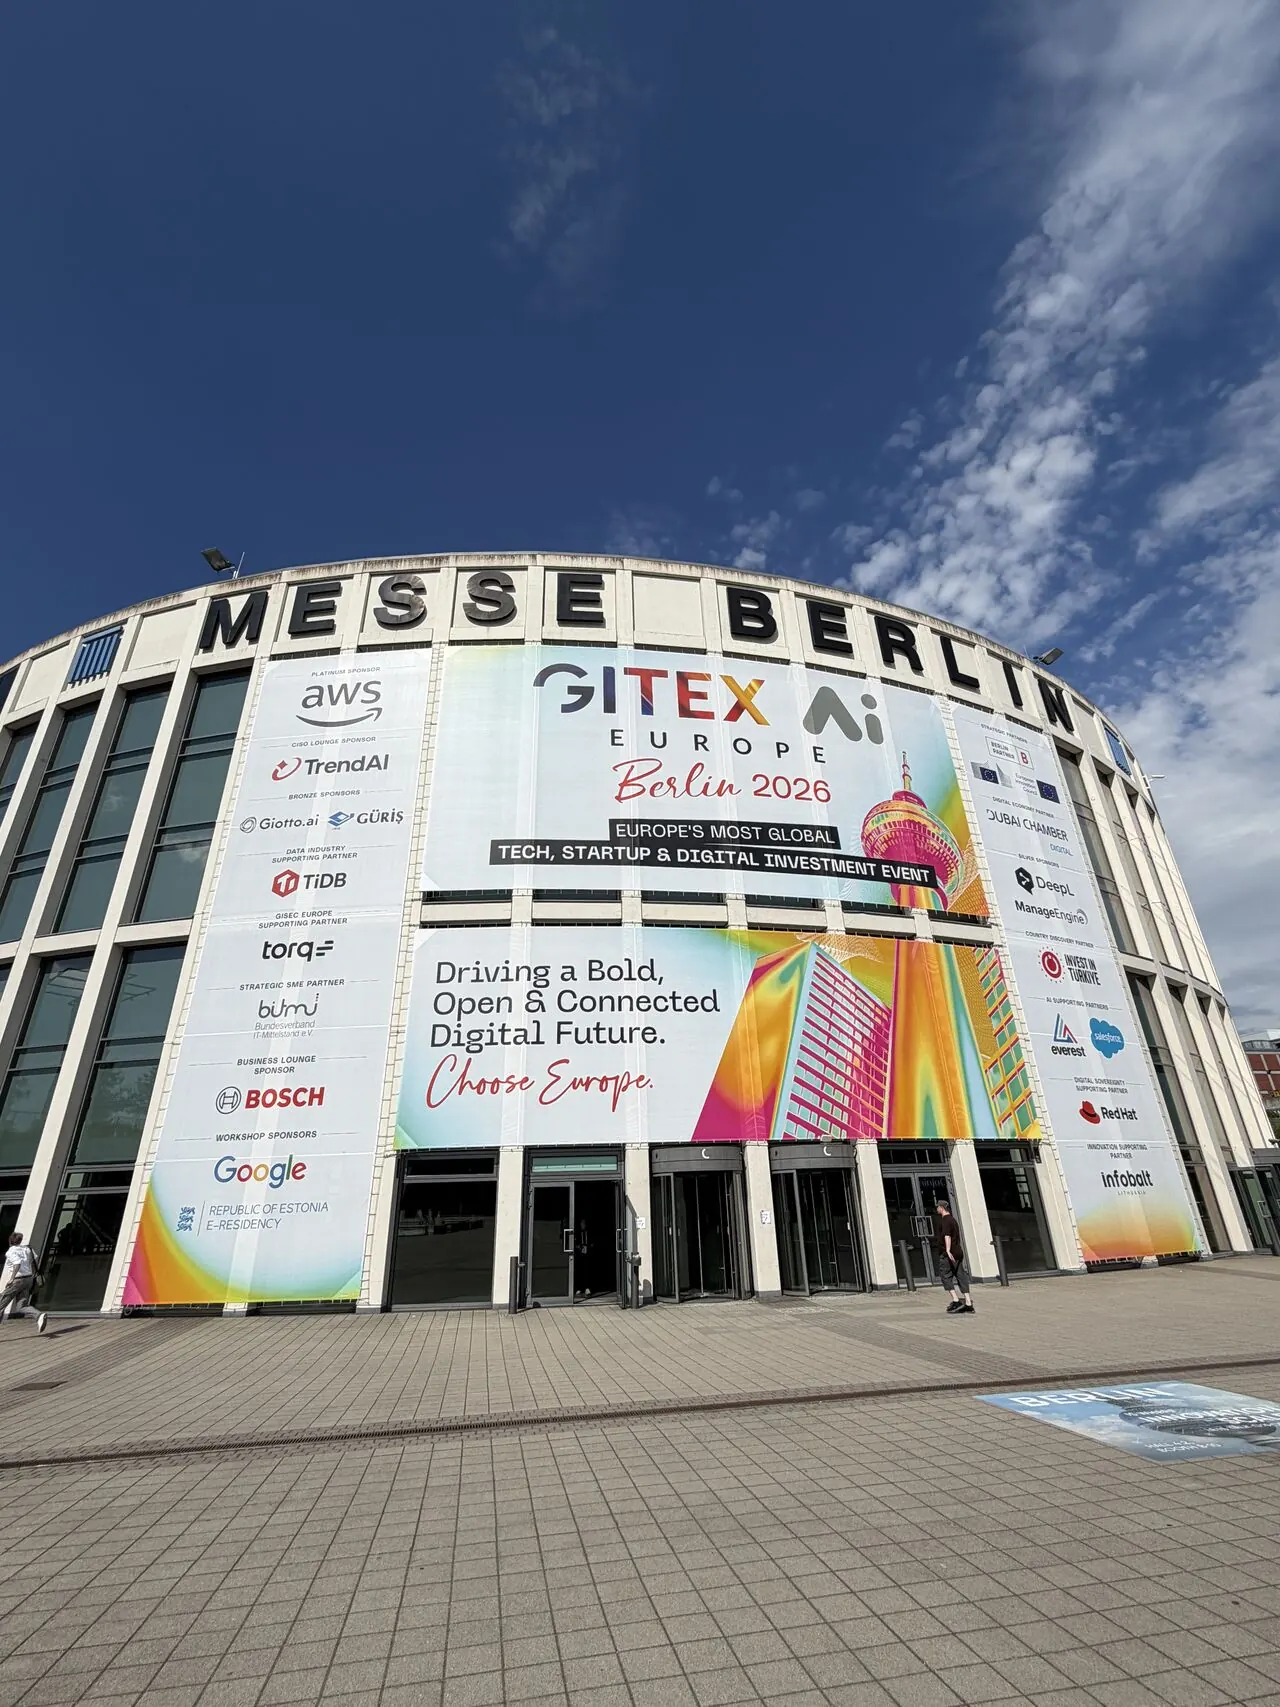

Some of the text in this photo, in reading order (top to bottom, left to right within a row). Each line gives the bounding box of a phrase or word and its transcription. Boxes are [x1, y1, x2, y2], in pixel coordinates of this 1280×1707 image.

[199, 571, 1074, 733] MESSE BERLIN
[312, 668, 346, 677] PLATINUM
[302, 680, 382, 708] aws
[533, 663, 770, 726] GITEX
[310, 738, 339, 746] LOUNGE
[610, 729, 826, 764] EUROPE
[991, 742, 1008, 751] BERLIN
[992, 748, 1014, 758] PARTNER
[1020, 752, 1028, 764] B
[305, 754, 389, 776] TrendAI
[612, 758, 832, 804] Berlin 2026
[320, 790, 360, 798] SPONSORS
[992, 796, 1011, 806] DIGITAL
[259, 814, 320, 830] Giotto.ai
[356, 808, 404, 824] GÜRİŞ
[616, 822, 835, 844] EUROPE'S MOST GLOBAL
[986, 808, 1068, 842] DUBAI CHAMBER
[272, 852, 358, 864] SUPPORTING PARTNER
[1050, 844, 1074, 856] DIGITAL
[498, 845, 930, 882] TECH, STARTUP & DIGITAL INVESTMENT EVENT
[303, 872, 347, 890] TiDB
[1036, 876, 1074, 896] DeepL
[276, 910, 332, 920] GISEC EUROPE
[1014, 900, 1086, 924] ManageEngine
[258, 918, 348, 929] SUPPORTING PARTNER
[262, 940, 314, 962] torq
[1064, 954, 1096, 971] INVEST IN
[436, 958, 664, 988] Driving a Bold,
[240, 982, 284, 991] STRATEGIC
[306, 979, 344, 987] PARTNER
[433, 988, 720, 1021] Open & Connected
[1052, 998, 1084, 1006] SUPPORTING
[254, 1020, 316, 1030] Bundesverband
[430, 1020, 665, 1054] Digital Future.
[1094, 1032, 1122, 1043] salesforce
[1052, 1046, 1086, 1056] everest
[236, 1056, 316, 1066] BUSINESS LOUNGE
[254, 1066, 295, 1075] SPONSOR
[426, 1054, 654, 1112] Choose Europe.
[245, 1086, 325, 1109] BOSCH
[216, 1130, 317, 1142] WORKSHOP SPONSORS
[214, 1154, 306, 1189] Google
[1100, 1170, 1154, 1188] infobalt
[209, 1202, 328, 1216] REPUBLIC OF ESTONIA
[1008, 1388, 1176, 1406] BERLIN
